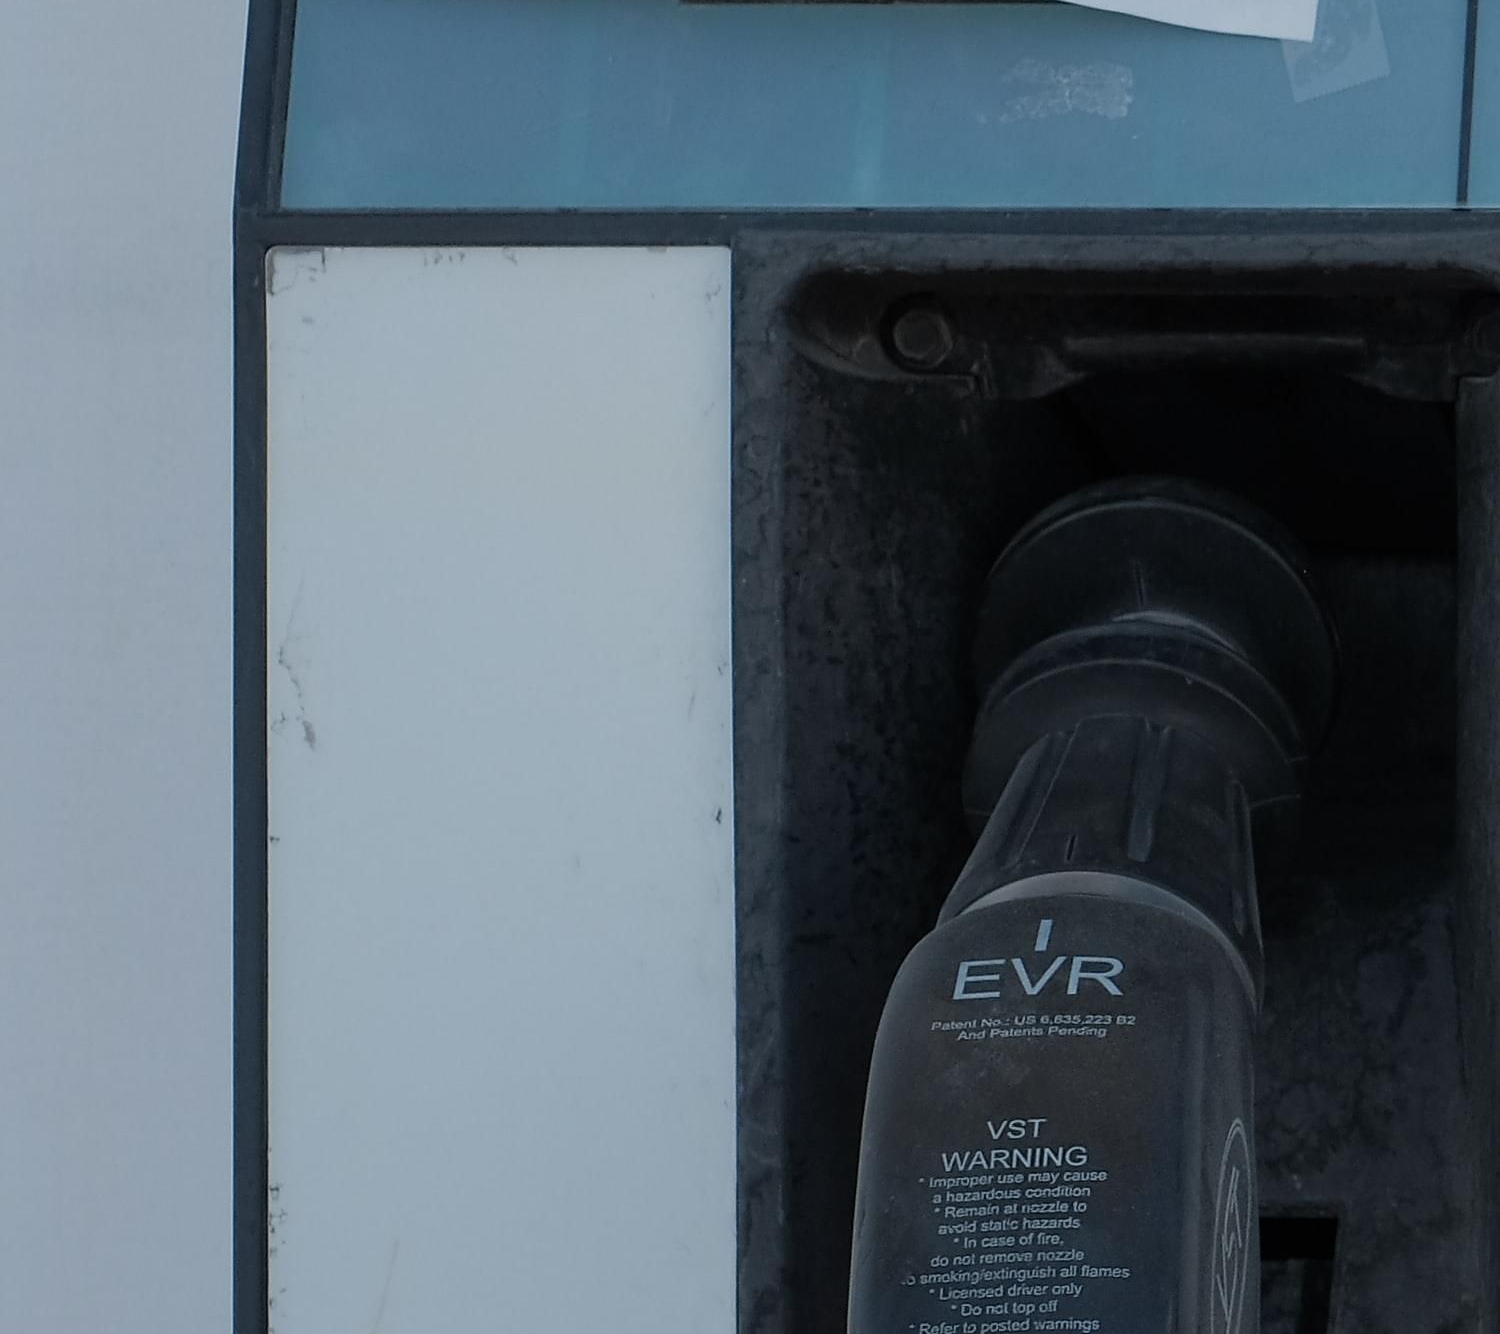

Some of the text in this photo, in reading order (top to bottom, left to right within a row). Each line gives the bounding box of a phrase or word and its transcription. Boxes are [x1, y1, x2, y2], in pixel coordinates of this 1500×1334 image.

[952, 955, 1124, 1000] EVR
[986, 1118, 1048, 1139] VST
[941, 1146, 1088, 1172] WARNING
[929, 1170, 1108, 1188] Improper use may cause
[932, 1186, 1091, 1204] a hazardous condition
[945, 1201, 1087, 1218] Remain at nozzle to
[930, 1249, 1085, 1267] do not remove nozzle
[1060, 1266, 1076, 1278] all
[1081, 1265, 1130, 1278] flames
[940, 1283, 1082, 1301] Licensed driver only
[961, 1299, 1059, 1316] Do not top off
[963, 1323, 976, 1334] to
[980, 1318, 1030, 1334] posted
[1033, 1318, 1100, 1333] warnings
